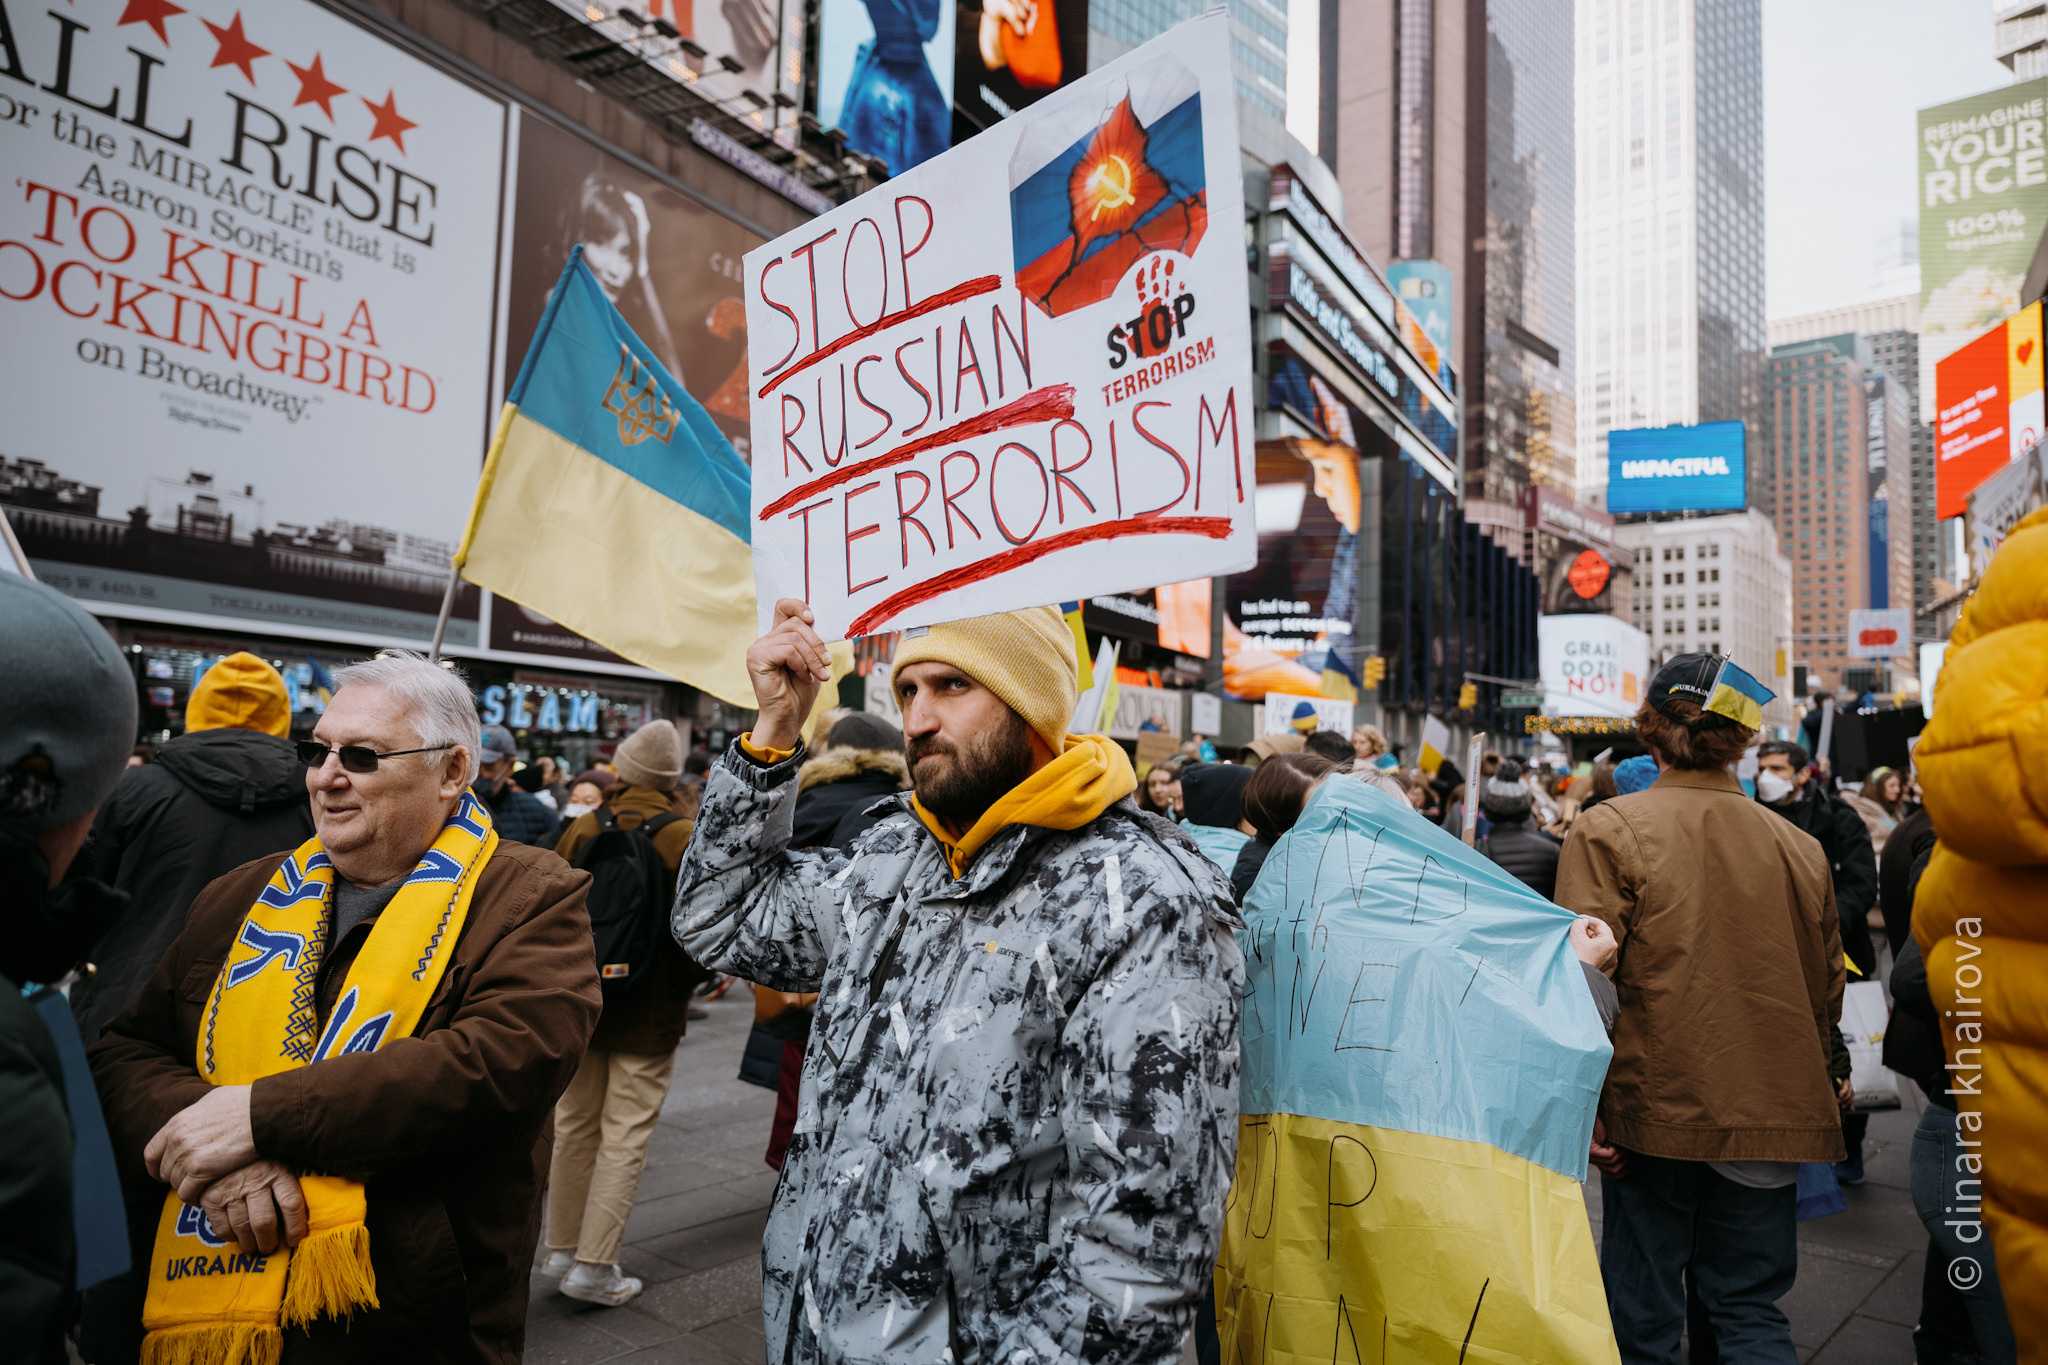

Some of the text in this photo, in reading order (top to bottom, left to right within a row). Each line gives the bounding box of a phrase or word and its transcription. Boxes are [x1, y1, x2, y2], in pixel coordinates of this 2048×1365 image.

[1924, 98, 2045, 145] REIMAGINE
[1926, 117, 2043, 170] YOUR
[51, 107, 118, 159] the
[129, 136, 314, 236] MIRACLE
[323, 216, 385, 263] that
[391, 242, 417, 275] is
[76, 163, 204, 231] Aaron
[220, 91, 438, 248] RISE
[1925, 146, 2048, 208] RICE
[1945, 208, 2026, 239] 100%
[159, 229, 326, 330] KILL
[340, 299, 382, 350] A
[760, 196, 934, 376] STOP
[1290, 262, 1320, 318] Kids
[77, 337, 125, 371] on
[1107, 293, 1195, 369] STOP
[782, 294, 1033, 478] RUSSIAN
[1101, 336, 1216, 407] TERRORISM
[788, 387, 1244, 604] TERRORISM
[1622, 456, 1730, 479] IMPACTFUL
[482, 685, 599, 732] SLAM
[1678, 683, 1710, 698] UKRAIN
[167, 1253, 268, 1281] UKRAINE
